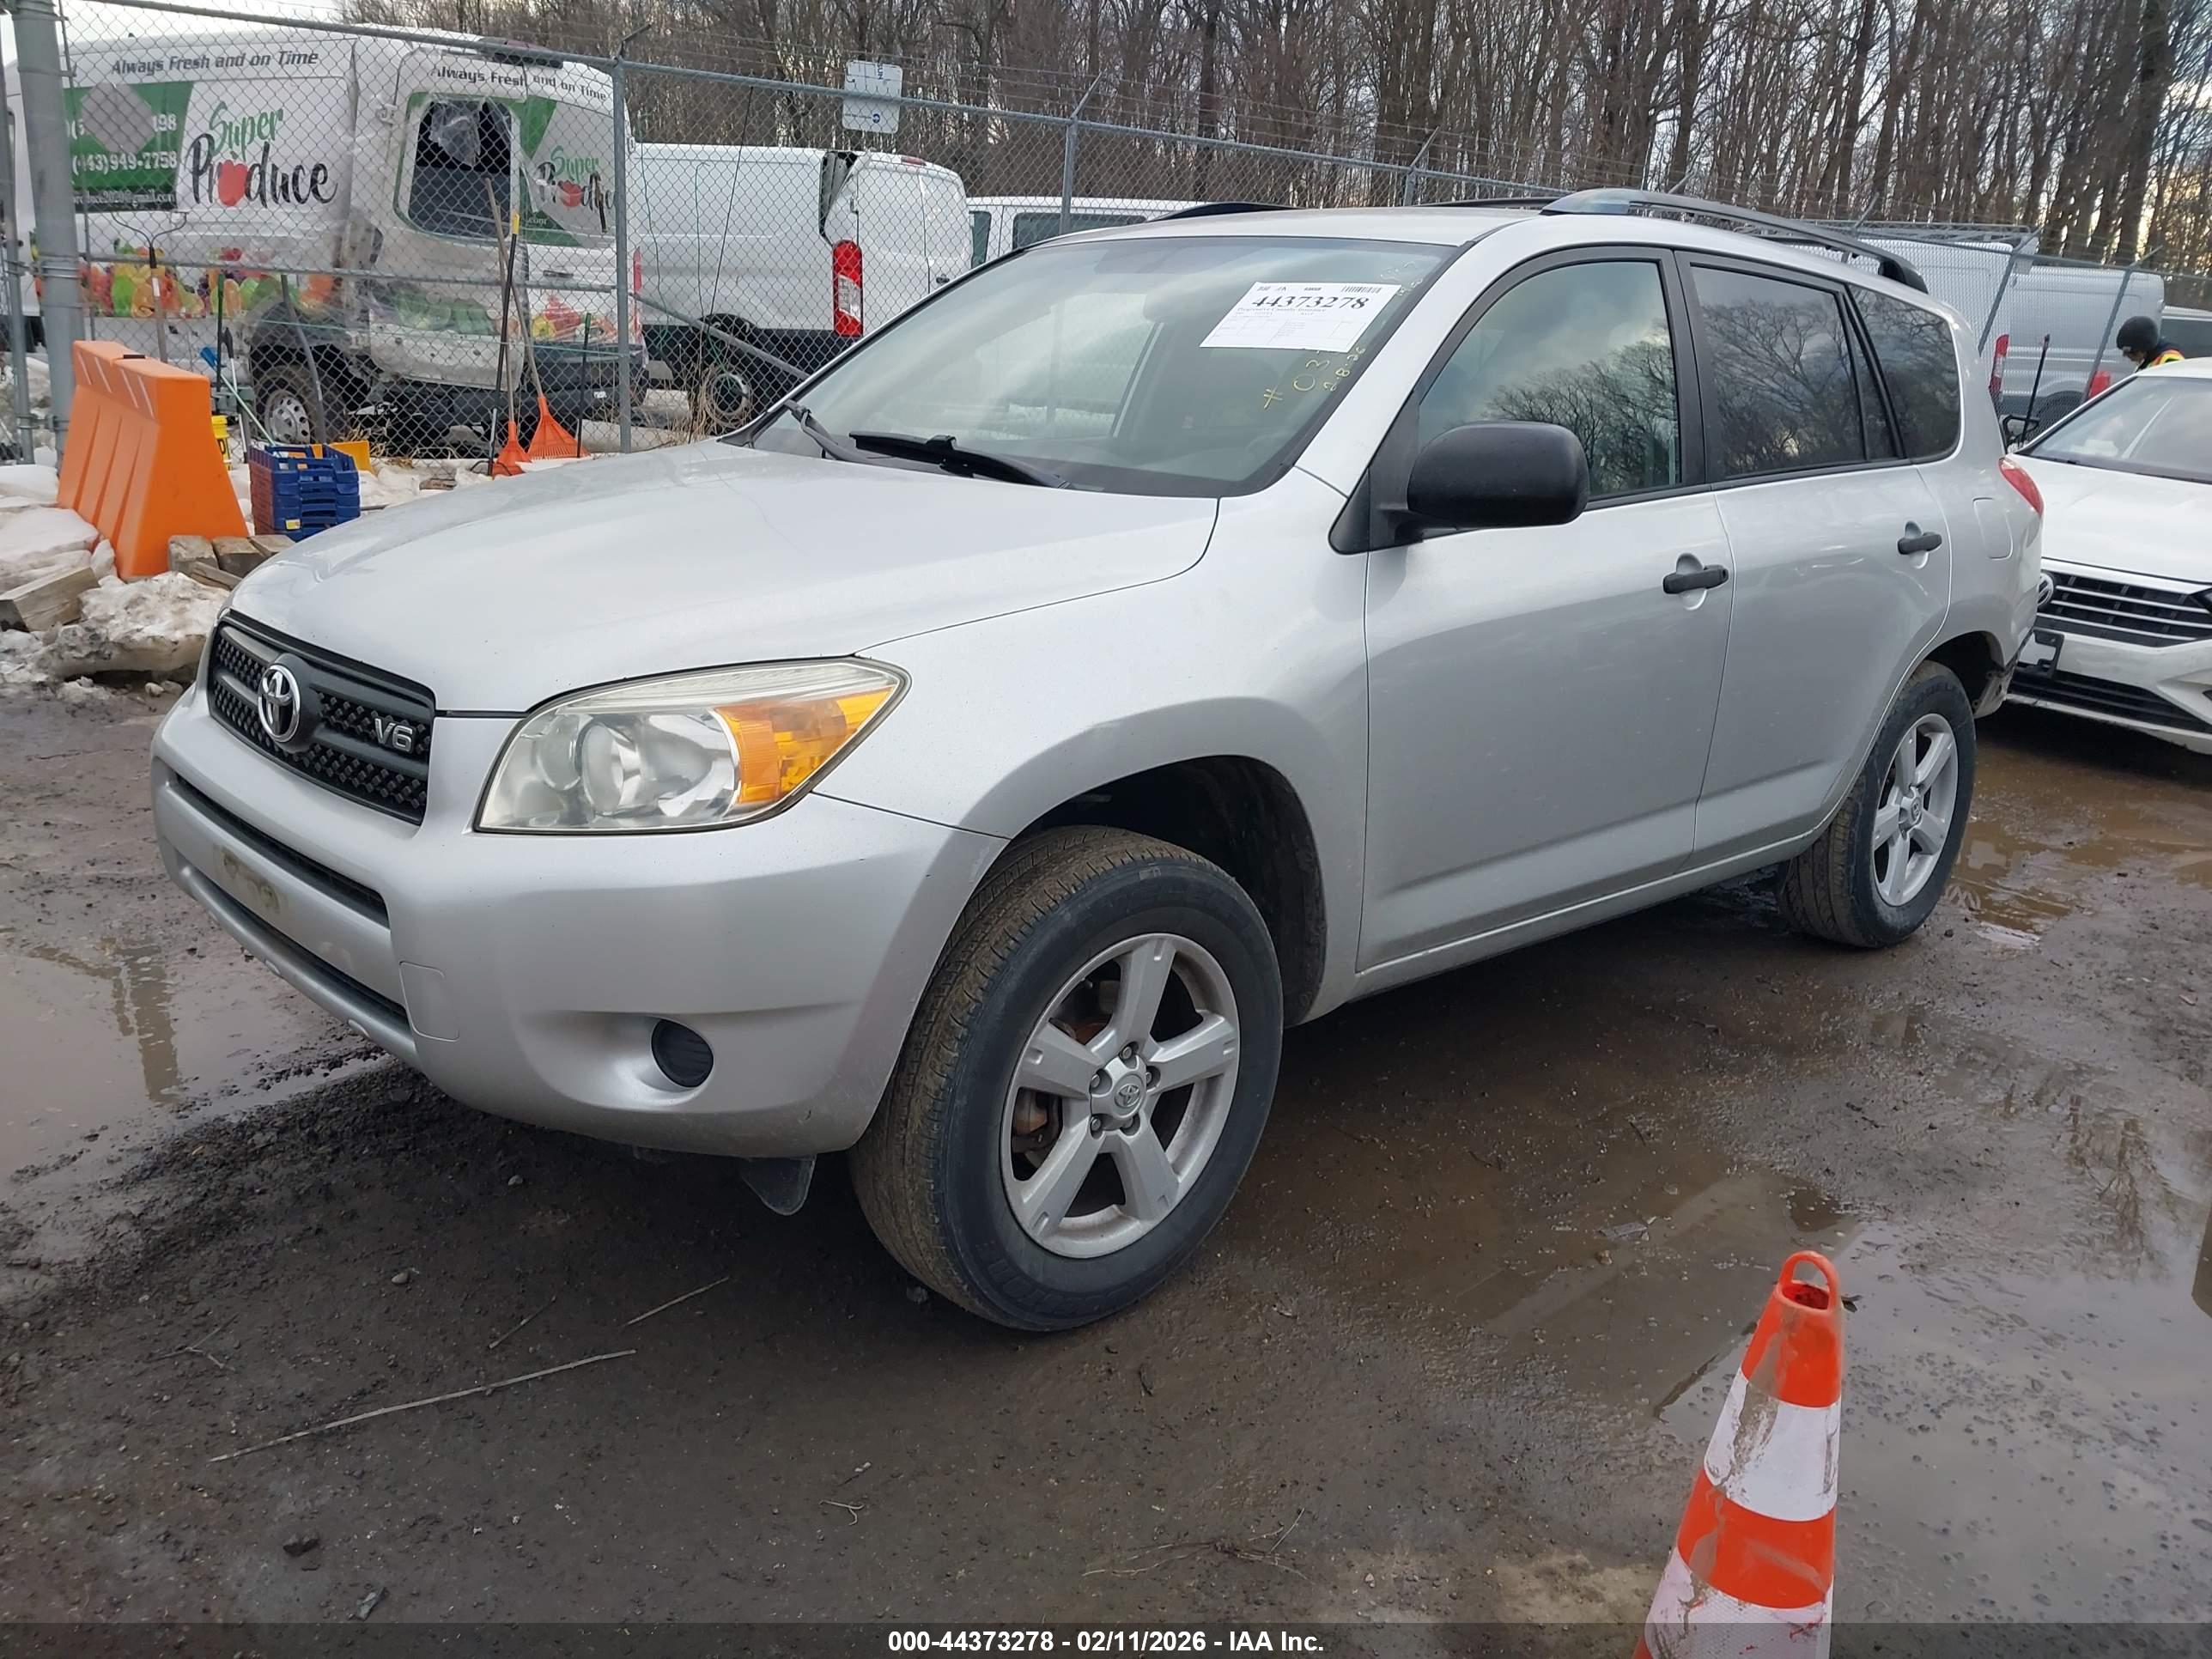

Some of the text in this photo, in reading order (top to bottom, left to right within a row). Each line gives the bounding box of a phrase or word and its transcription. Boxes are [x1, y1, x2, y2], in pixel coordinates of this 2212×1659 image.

[112, 51, 319, 76] Always Fresh and on Time
[431, 66, 606, 101] Always Fresh and on Time
[210, 101, 284, 162] Super
[185, 133, 338, 209] Produce
[550, 144, 599, 183] Super
[1251, 295, 1370, 310] 44373278
[374, 718, 413, 753] V6
